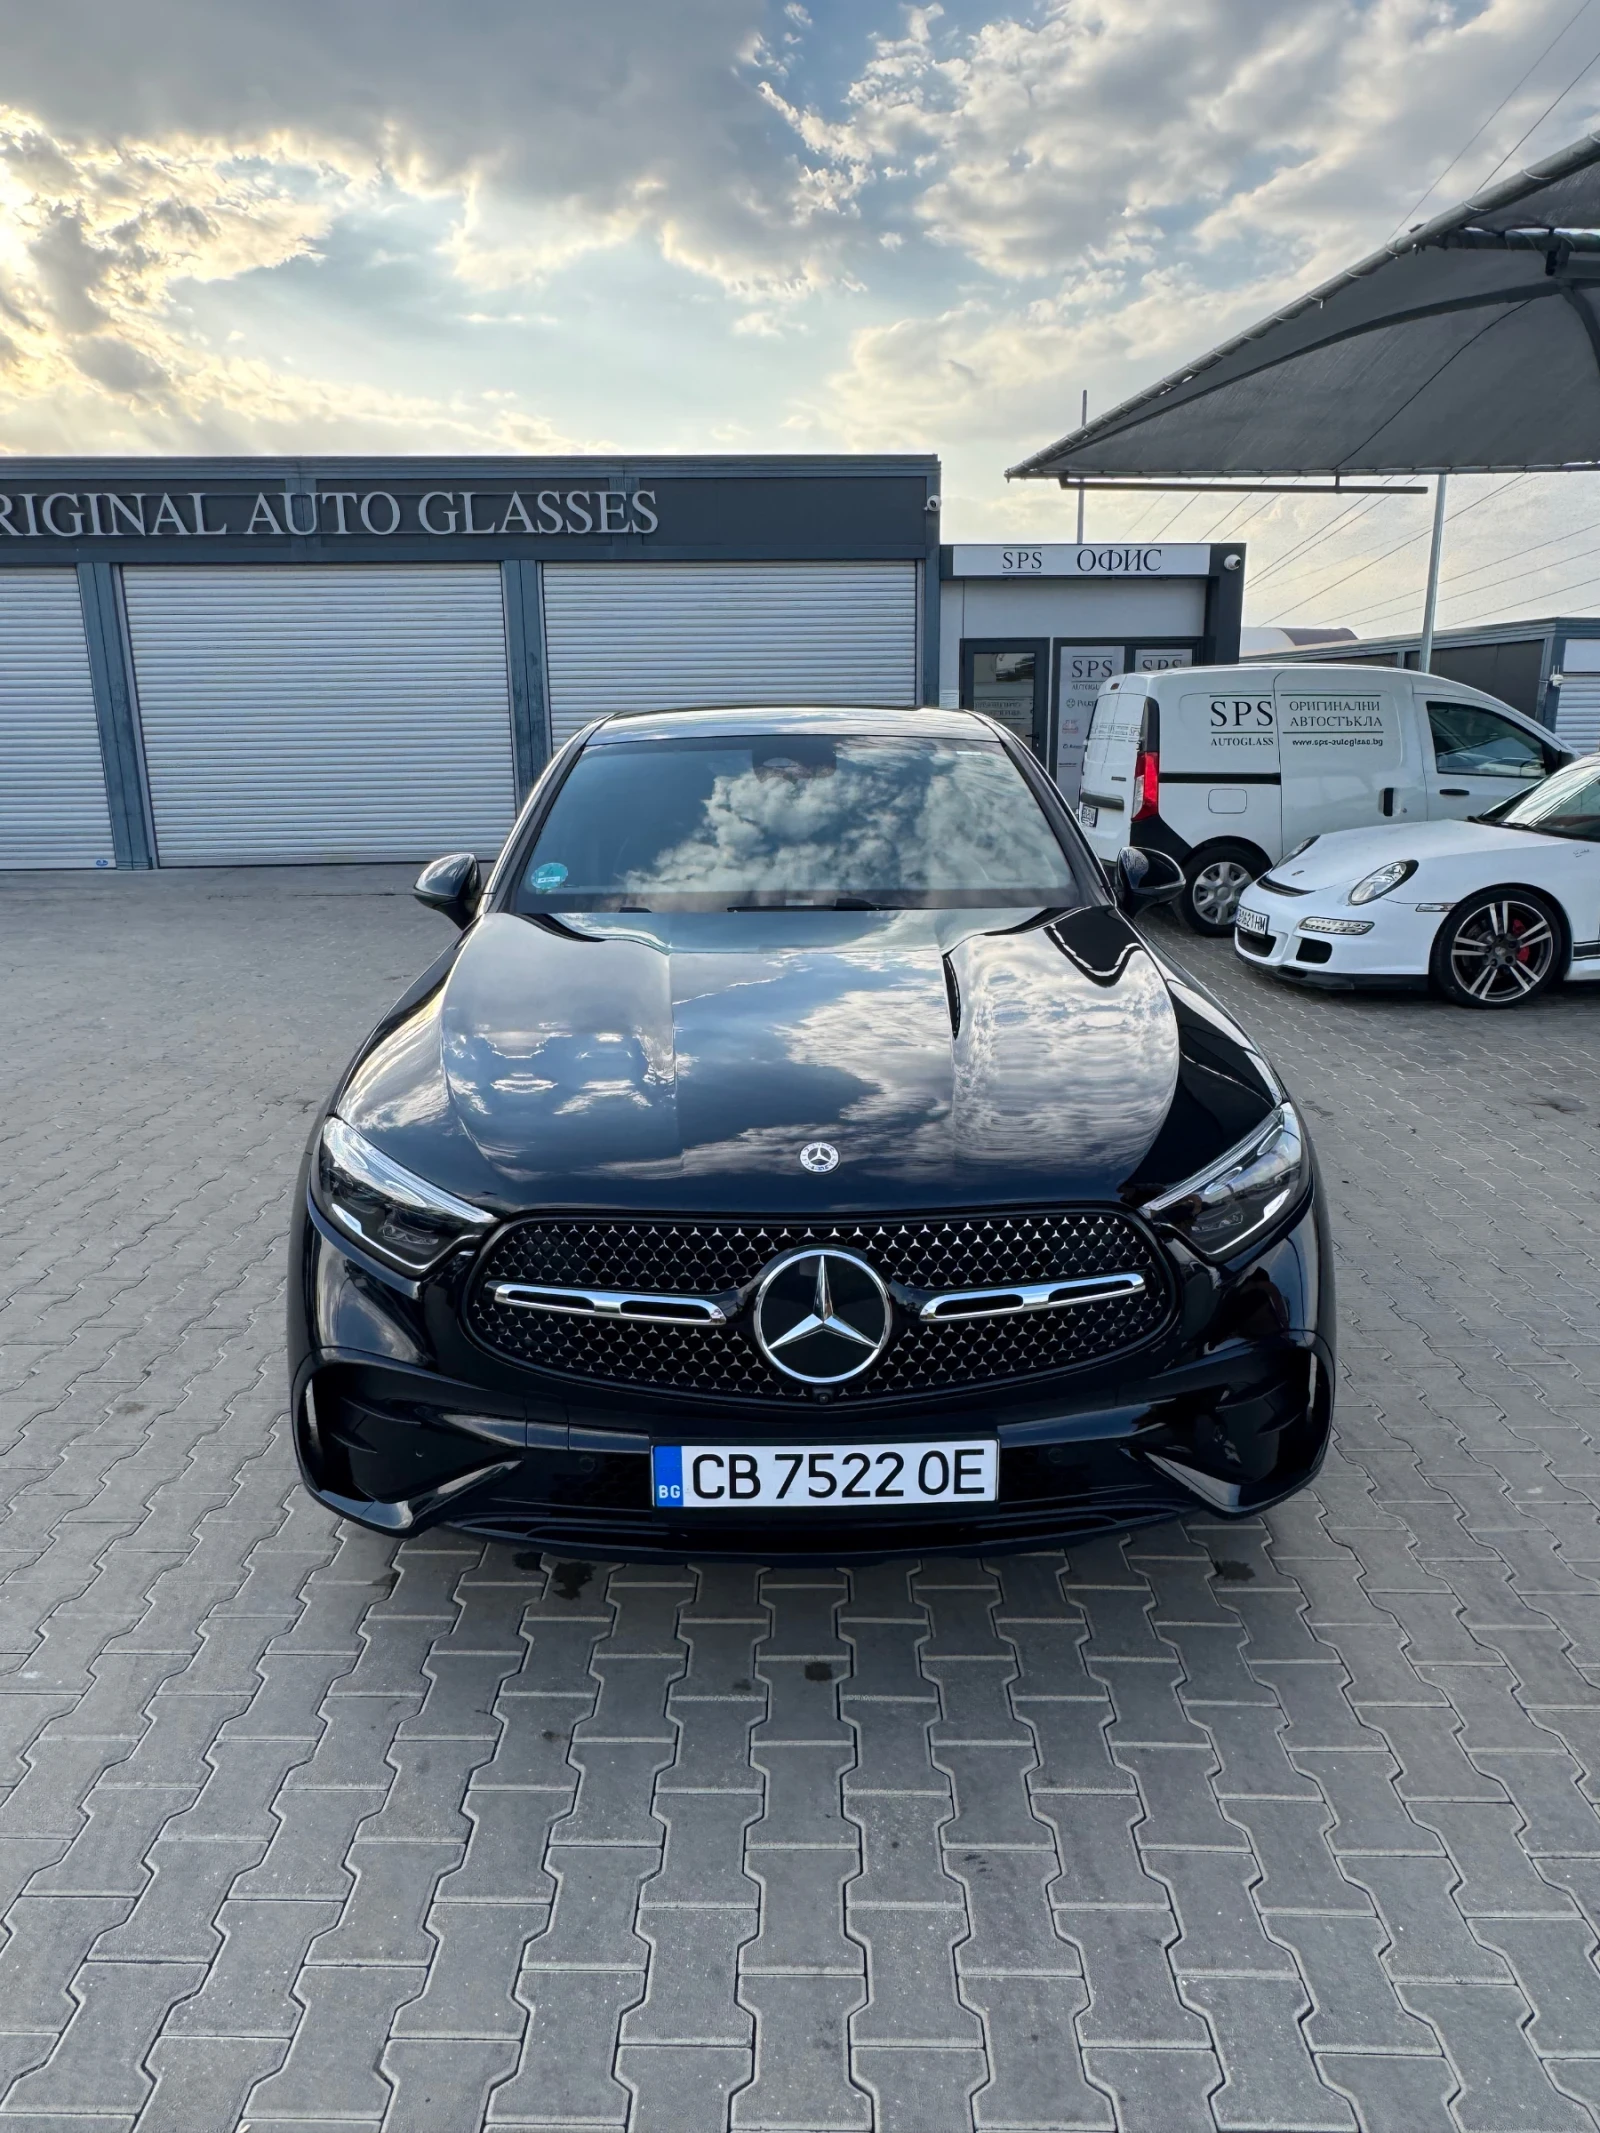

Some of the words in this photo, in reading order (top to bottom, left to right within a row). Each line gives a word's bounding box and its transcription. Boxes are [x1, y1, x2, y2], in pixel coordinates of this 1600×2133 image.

[247, 491, 401, 536] AUTO
[418, 490, 659, 535] GLASSES
[1002, 551, 1042, 569] SPS
[1076, 548, 1162, 572] ОФИС
[1071, 659, 1113, 678] SPS
[1210, 700, 1274, 727] SPS
[1289, 700, 1381, 711] ОРИГИНАЛНИ
[1290, 716, 1383, 727] АВТОСТЪКЛА
[1210, 737, 1274, 746] AUTOGLASS
[774, 1451, 905, 1499] 7522
[658, 1484, 681, 1499] BG
